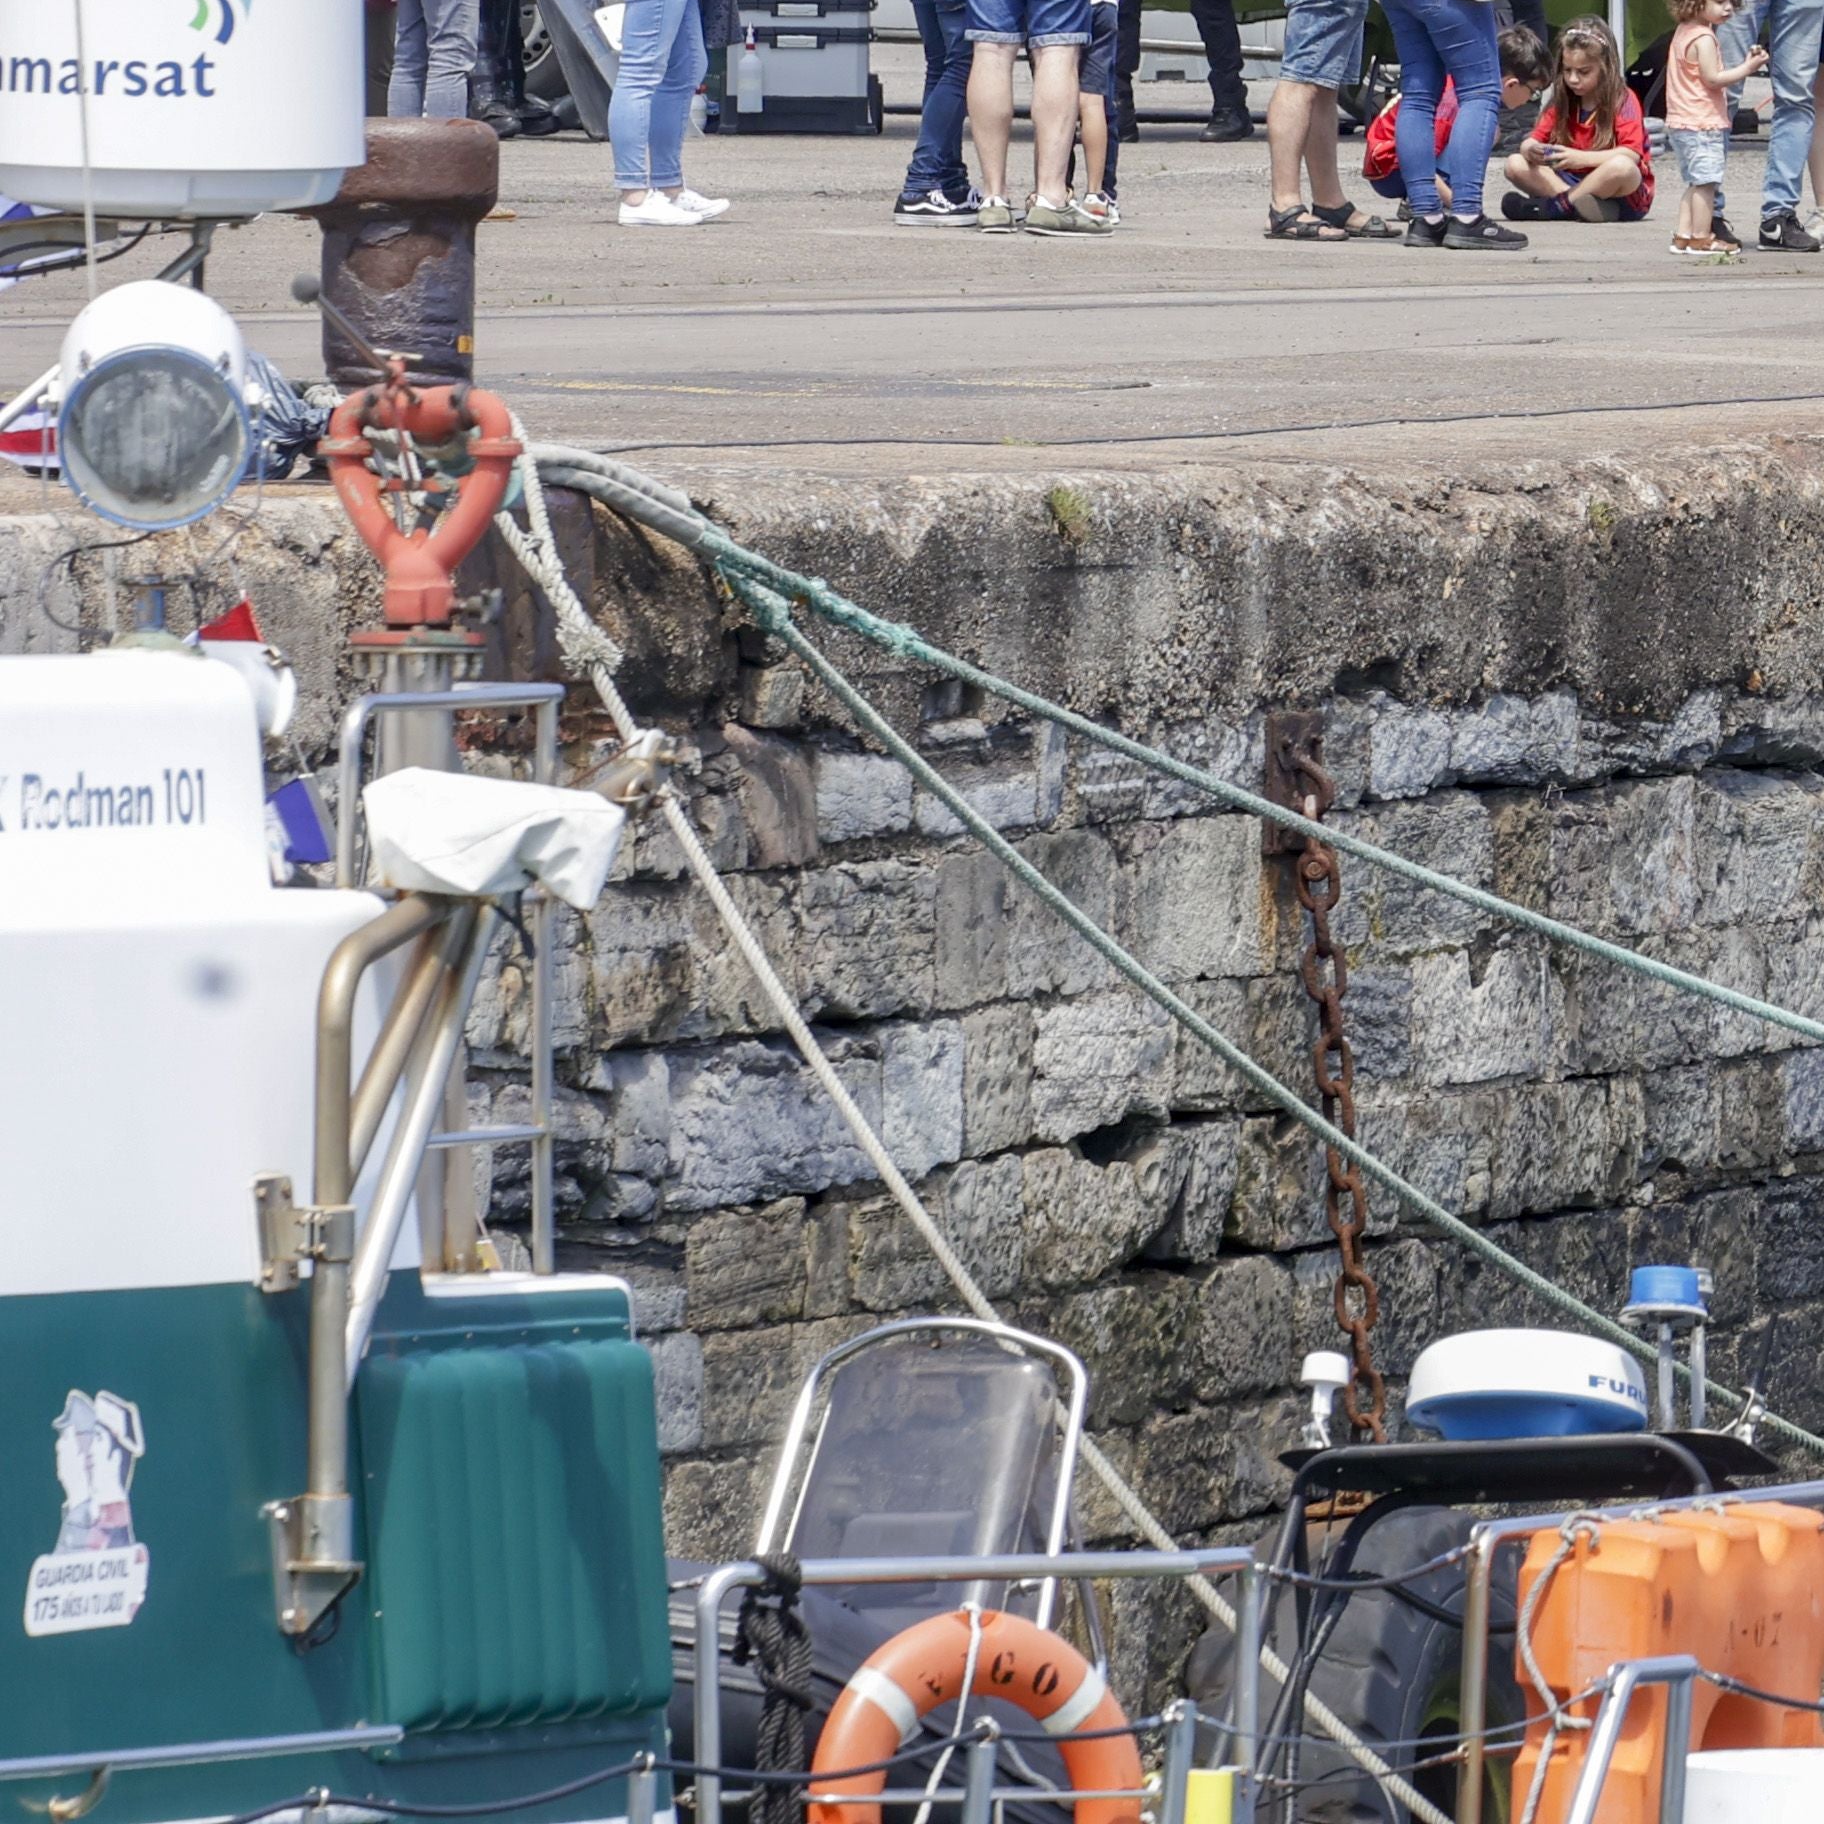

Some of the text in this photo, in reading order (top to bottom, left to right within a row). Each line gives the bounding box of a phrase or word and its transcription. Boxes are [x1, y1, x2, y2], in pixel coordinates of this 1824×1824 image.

[0, 50, 216, 98] marsat
[21, 770, 154, 830] Rodman
[163, 768, 205, 825] 101
[35, 1558, 129, 1589] GUARDIA CIVIL
[33, 1595, 60, 1623] 175
